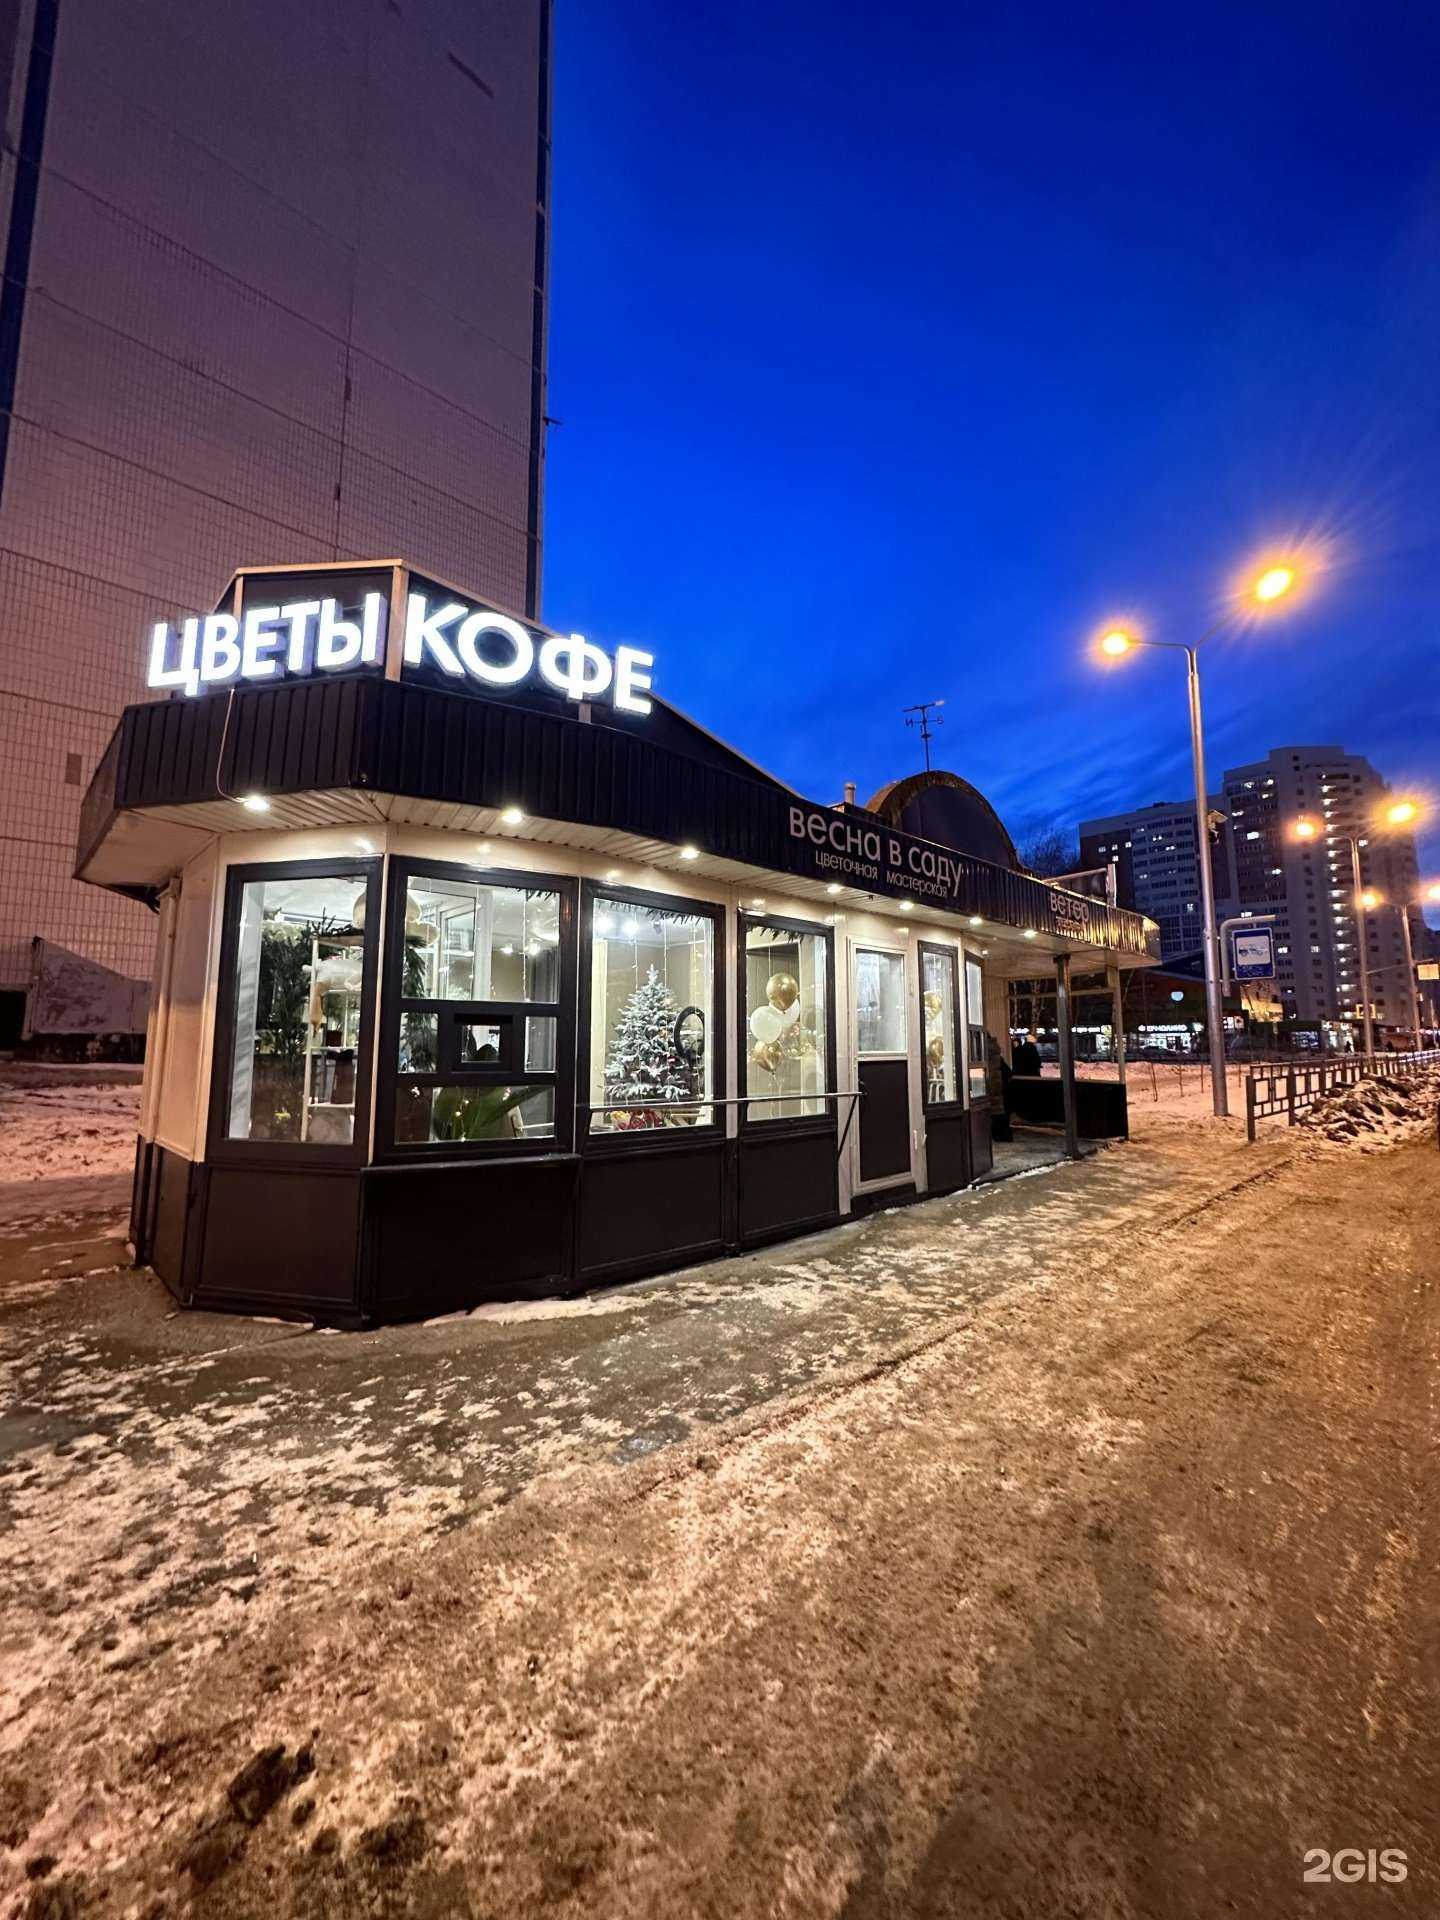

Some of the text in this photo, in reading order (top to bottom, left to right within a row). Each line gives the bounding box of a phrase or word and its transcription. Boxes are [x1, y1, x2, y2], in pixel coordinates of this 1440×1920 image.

[147, 592, 382, 697] ЦВЕТЫ
[404, 593, 655, 715] КОФЕ
[815, 850, 948, 898] цветочная мастерская
[908, 846, 963, 897] саду
